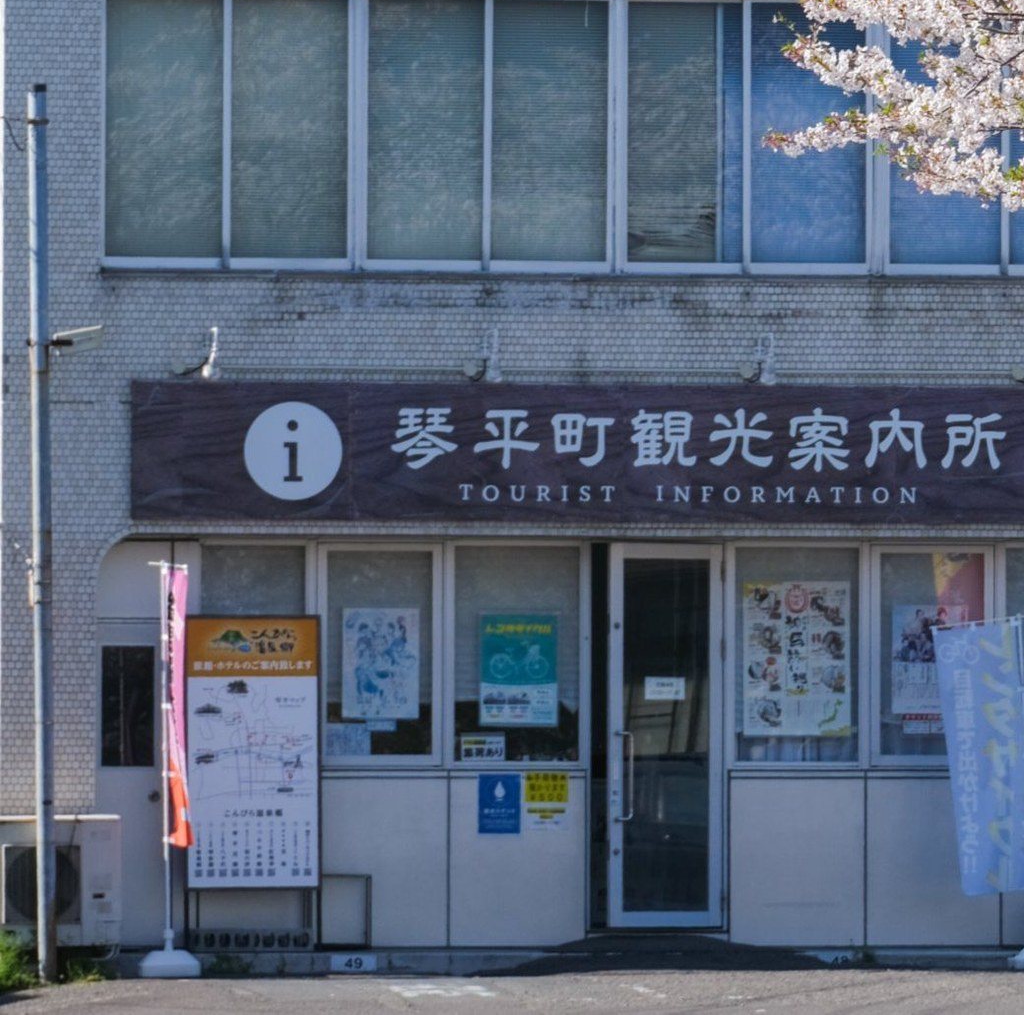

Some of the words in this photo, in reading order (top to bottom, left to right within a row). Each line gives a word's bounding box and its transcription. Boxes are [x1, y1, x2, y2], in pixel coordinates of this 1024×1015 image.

[390, 407, 1007, 473] 琴平町観光案内所
[459, 484, 616, 502] TOURIST
[656, 485, 918, 504] INFORMATION
[344, 957, 363, 969] 49
